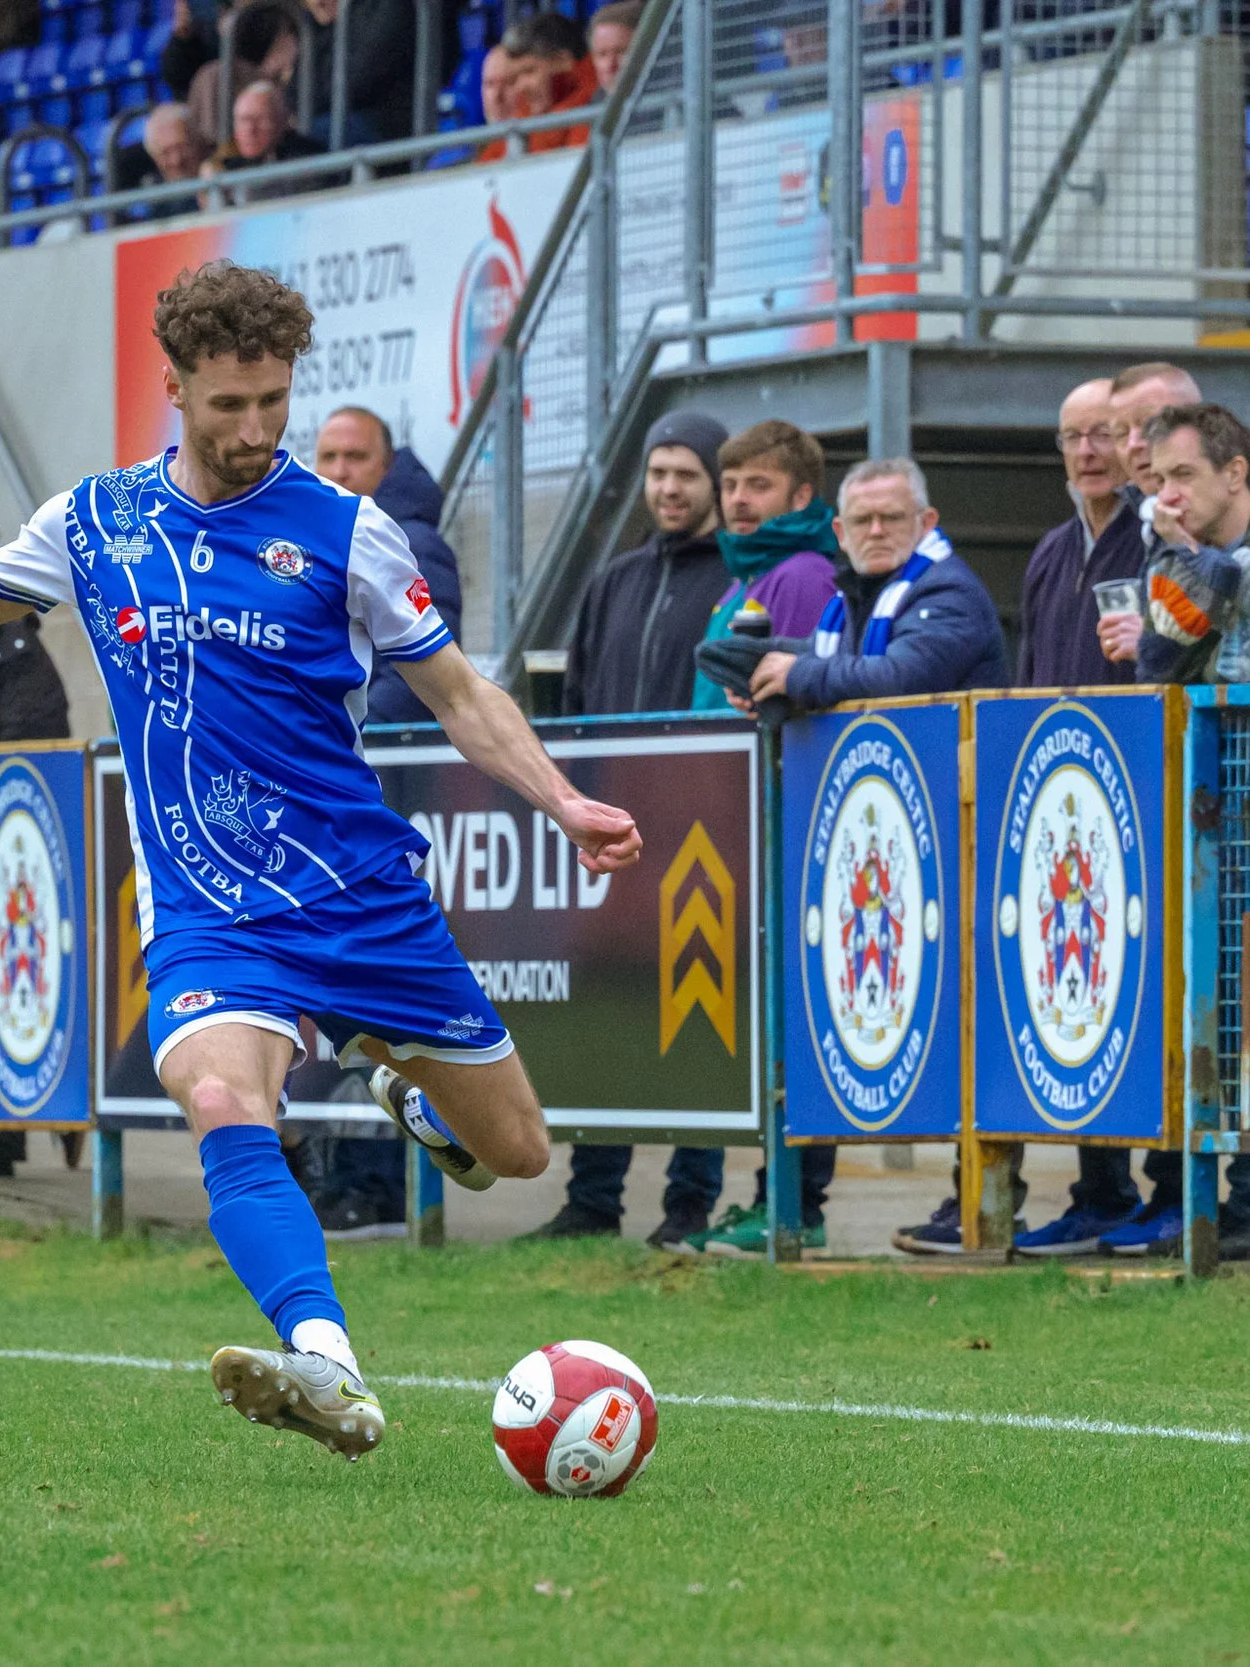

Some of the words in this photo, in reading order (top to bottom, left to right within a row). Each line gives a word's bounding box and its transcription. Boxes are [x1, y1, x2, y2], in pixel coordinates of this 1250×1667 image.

[315, 250, 361, 309] 330
[377, 328, 416, 386] 777
[190, 530, 214, 573] 6
[148, 605, 286, 651] Fidelis
[814, 740, 892, 866] STALYBRIDGE
[892, 757, 932, 860] CELTIC
[1009, 727, 1092, 854] STALYBRIDGE
[1093, 747, 1135, 853] CELTIC
[208, 811, 245, 834] ABSQUE
[467, 961, 570, 1002] ENOVATION
[822, 1029, 890, 1112] FOOTBALL
[888, 1028, 923, 1099] CLUB
[1018, 1023, 1087, 1111] FOOTBALL
[1088, 1026, 1125, 1098] CLUB
